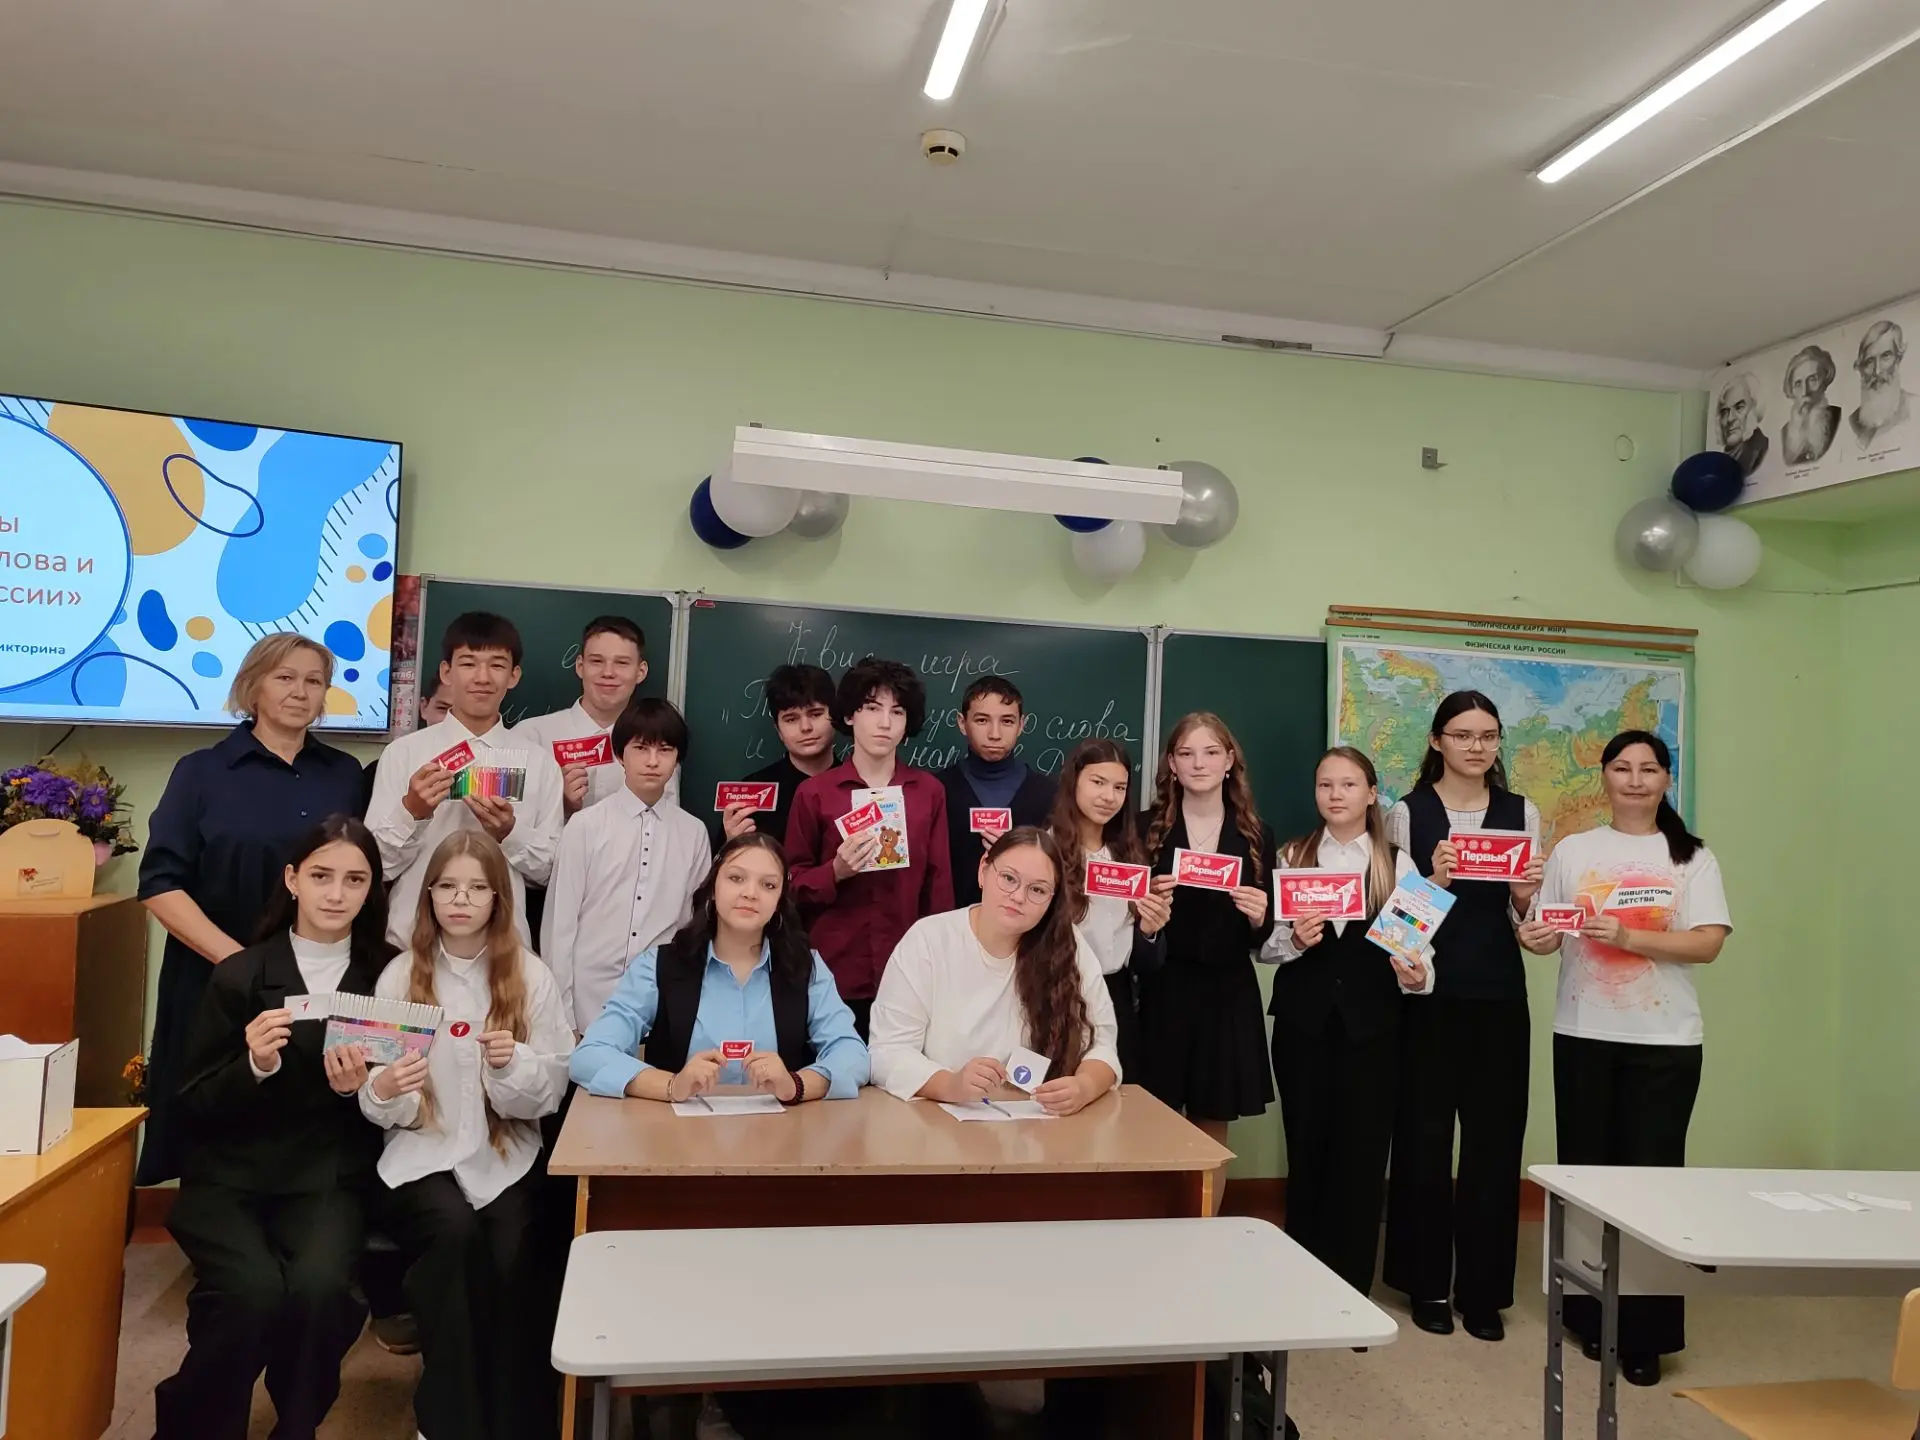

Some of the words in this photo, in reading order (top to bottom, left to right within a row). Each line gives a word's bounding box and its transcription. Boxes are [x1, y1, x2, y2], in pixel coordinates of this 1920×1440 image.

[77, 557, 94, 574] и
[1467, 621, 1520, 631] ПОЛИТИЧЕСКАЯ
[1547, 626, 1567, 634] МИРА
[1464, 641, 1511, 651] ФИЗИЧЕСКАЯ
[1513, 644, 1535, 652] КАРТА
[1538, 647, 1566, 655] РОССИИ
[1045, 700, 1139, 741] слова
[1461, 850, 1508, 865] Первые
[1187, 864, 1222, 877] Первые
[1095, 874, 1130, 886] Первые
[1618, 888, 1672, 896] НАВИГАТОРЫ
[1617, 897, 1655, 906] ДЕТСТВА
